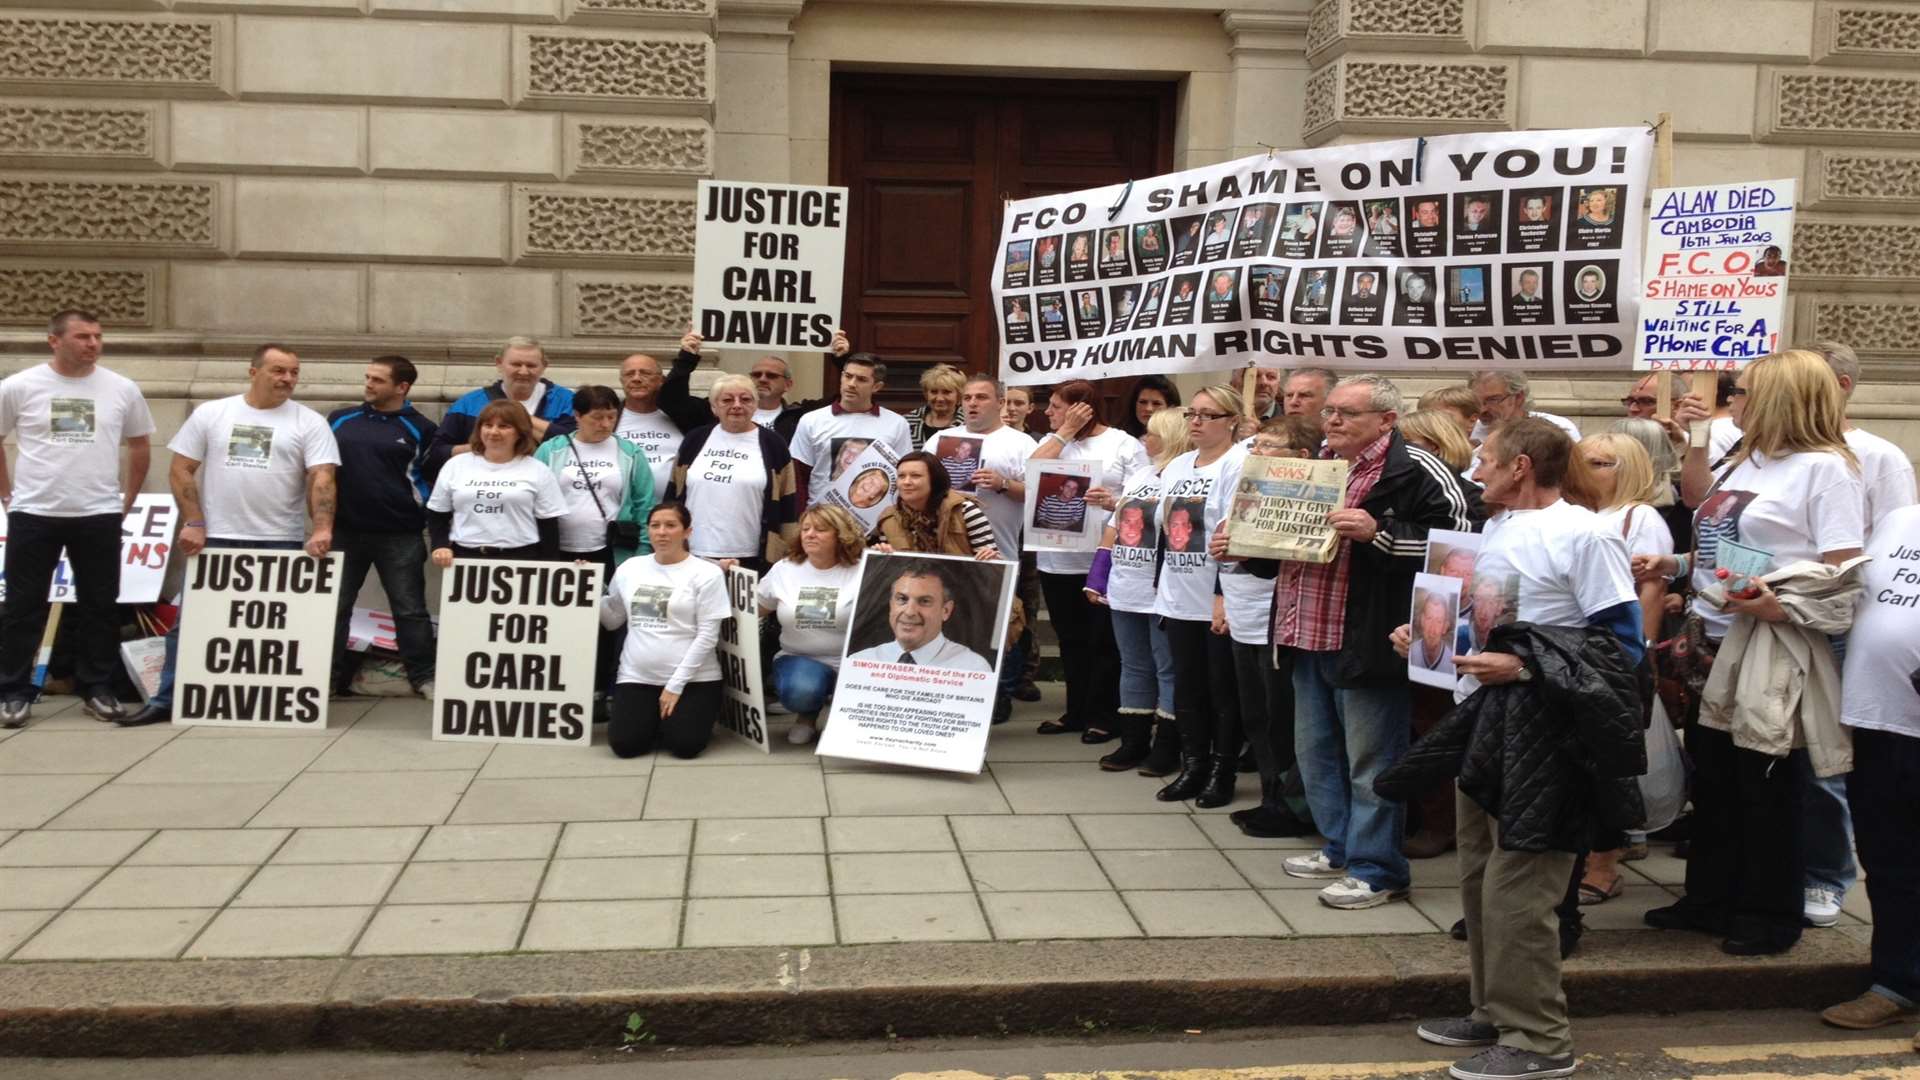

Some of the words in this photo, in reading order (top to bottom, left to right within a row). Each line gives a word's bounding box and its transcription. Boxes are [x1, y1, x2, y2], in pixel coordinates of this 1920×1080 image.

[1011, 202, 1087, 234] FCO
[1146, 166, 1321, 213] SHAME
[1340, 158, 1414, 191] ON
[1448, 146, 1627, 182] YOU!
[705, 186, 842, 228] JUSTICE
[1658, 190, 1718, 217] ALAN
[743, 231, 799, 261] FOR
[1680, 235, 1710, 249] 16TH
[1715, 234, 1740, 245] JAN
[722, 266, 816, 304] CARL
[1646, 279, 1708, 298] SHAME
[1711, 283, 1735, 297] ON
[701, 308, 833, 348] DAVIES
[1715, 320, 1745, 335] FOR
[1746, 318, 1767, 337] A
[1008, 348, 1078, 373] OUR
[1081, 333, 1197, 367] HUMAN
[1213, 328, 1388, 359] RIGHTS
[1404, 333, 1623, 360] DENIED
[1644, 335, 1707, 354] PHONE
[1711, 332, 1777, 357] CALL!
[624, 431, 671, 440] Justice
[636, 442, 660, 452] For
[703, 448, 749, 461] Justice
[564, 459, 614, 468] Justice
[648, 455, 662, 464] arl
[710, 460, 734, 471] For
[703, 471, 733, 484] Carl
[1265, 465, 1307, 480] NEWS
[464, 479, 517, 488] Justice
[572, 481, 602, 491] Carl
[475, 490, 502, 500] For
[473, 502, 504, 514] Carl
[1270, 497, 1306, 511] WON'T
[1306, 502, 1335, 514] GIVE
[1255, 519, 1276, 531] FOR
[1258, 508, 1274, 519] UP
[1274, 510, 1293, 522] MY
[1293, 512, 1329, 526] FIGHT
[1128, 547, 1158, 563] DALY
[1179, 553, 1208, 567] DALY
[192, 553, 335, 594] JUSTICE
[449, 564, 596, 608] JUSTICE
[1876, 588, 1920, 608] Carl
[229, 599, 287, 630] FOR
[488, 612, 548, 645] FOR
[721, 616, 739, 646] OR
[205, 637, 303, 676] CARL
[464, 651, 566, 692] CARL
[720, 650, 751, 695] ARL
[852, 660, 880, 670] SIMON
[881, 664, 917, 674] FRASER,
[919, 666, 941, 676] Head
[967, 672, 987, 681] FCO
[870, 671, 886, 679] and
[887, 672, 931, 683] Diplomatic
[932, 677, 964, 687] Service
[182, 683, 320, 724] DAVIES
[917, 690, 945, 699] FAMILIES
[442, 698, 585, 742] DAVIES
[839, 707, 879, 716] AUTHORITIES
[879, 711, 905, 719] INSTEAD
[913, 715, 943, 724] FIGHTING
[956, 719, 982, 728] BRITISH
[875, 717, 898, 725] RIGHTS
[921, 722, 941, 730] TRUTH
[938, 710, 966, 719] FOREIGN
[858, 722, 890, 731] HAPPENED
[914, 728, 934, 736] LOVED
